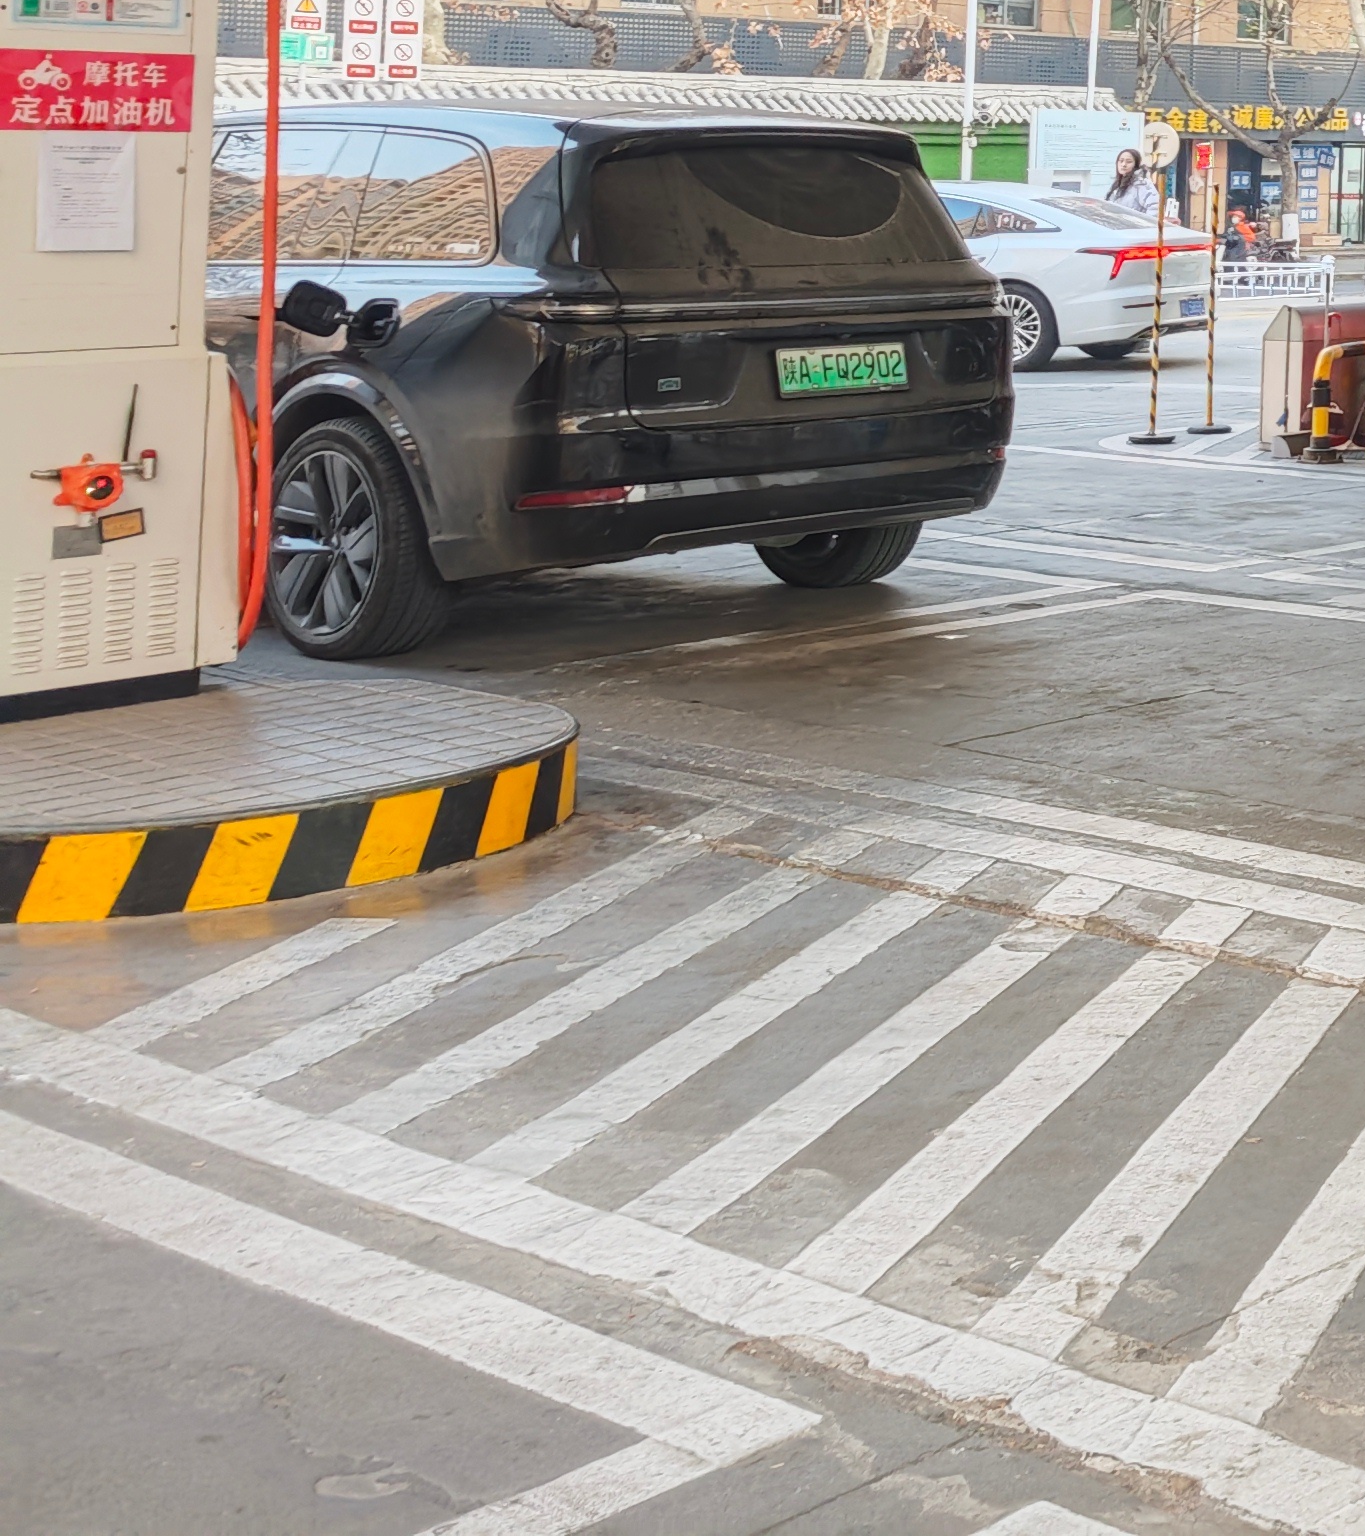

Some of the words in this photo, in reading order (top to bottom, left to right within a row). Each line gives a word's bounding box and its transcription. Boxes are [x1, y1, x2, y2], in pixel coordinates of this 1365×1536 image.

[82, 60, 168, 88] 摩托车
[9, 94, 176, 127] 定点加油机
